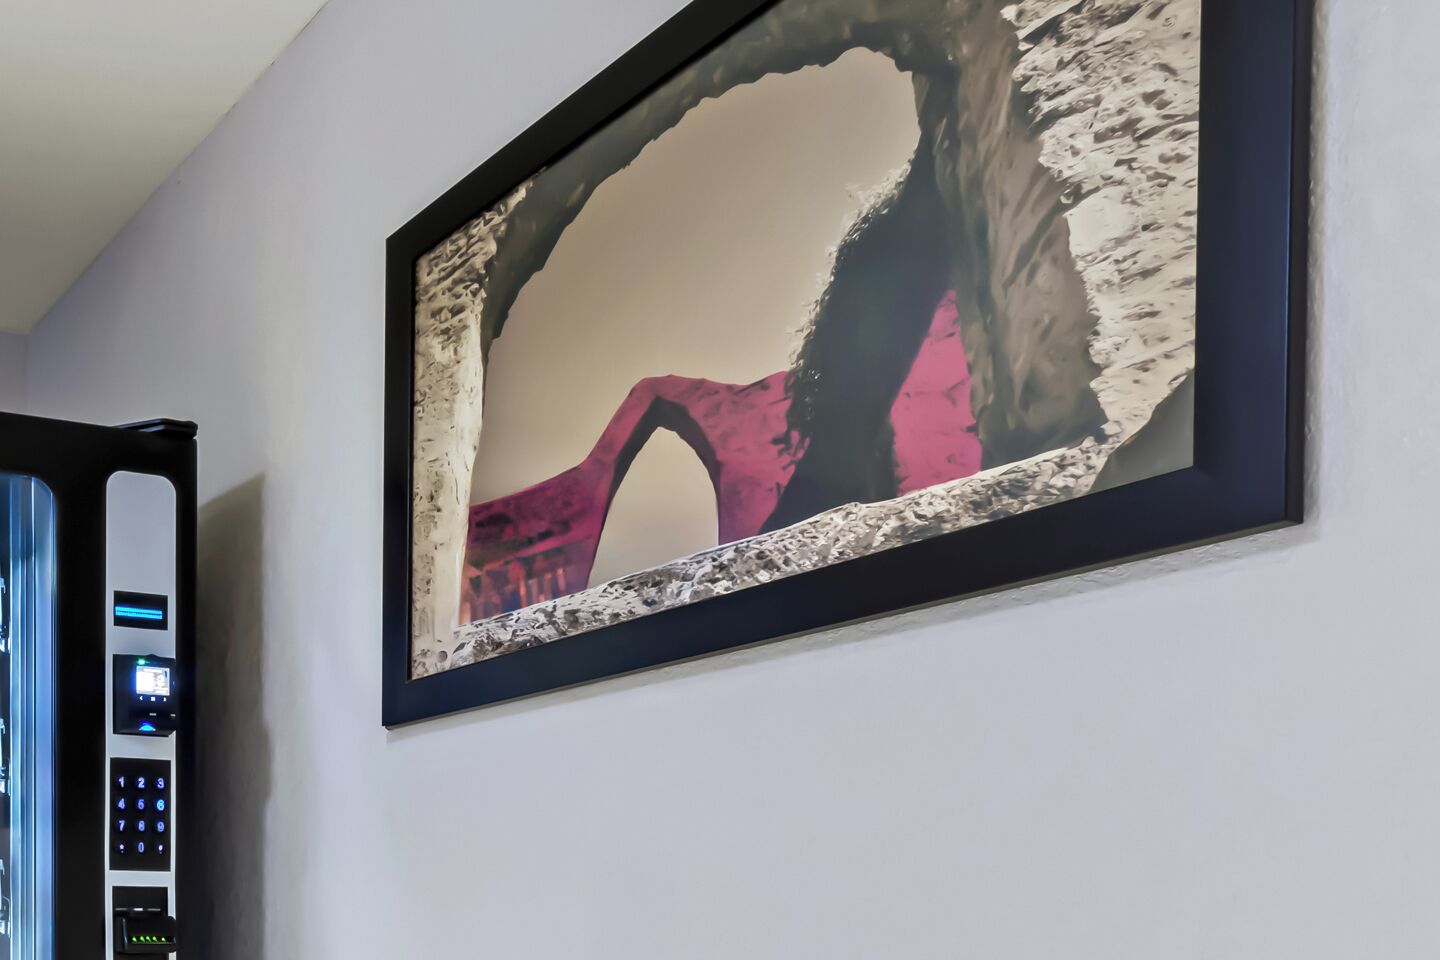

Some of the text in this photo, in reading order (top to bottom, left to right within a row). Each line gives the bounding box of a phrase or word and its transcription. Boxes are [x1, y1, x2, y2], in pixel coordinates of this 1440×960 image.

[118, 776, 165, 789] 1 2 3
[118, 798, 165, 811] 4 5 6
[118, 820, 165, 833] 7 8 9
[137, 842, 145, 853] 0
